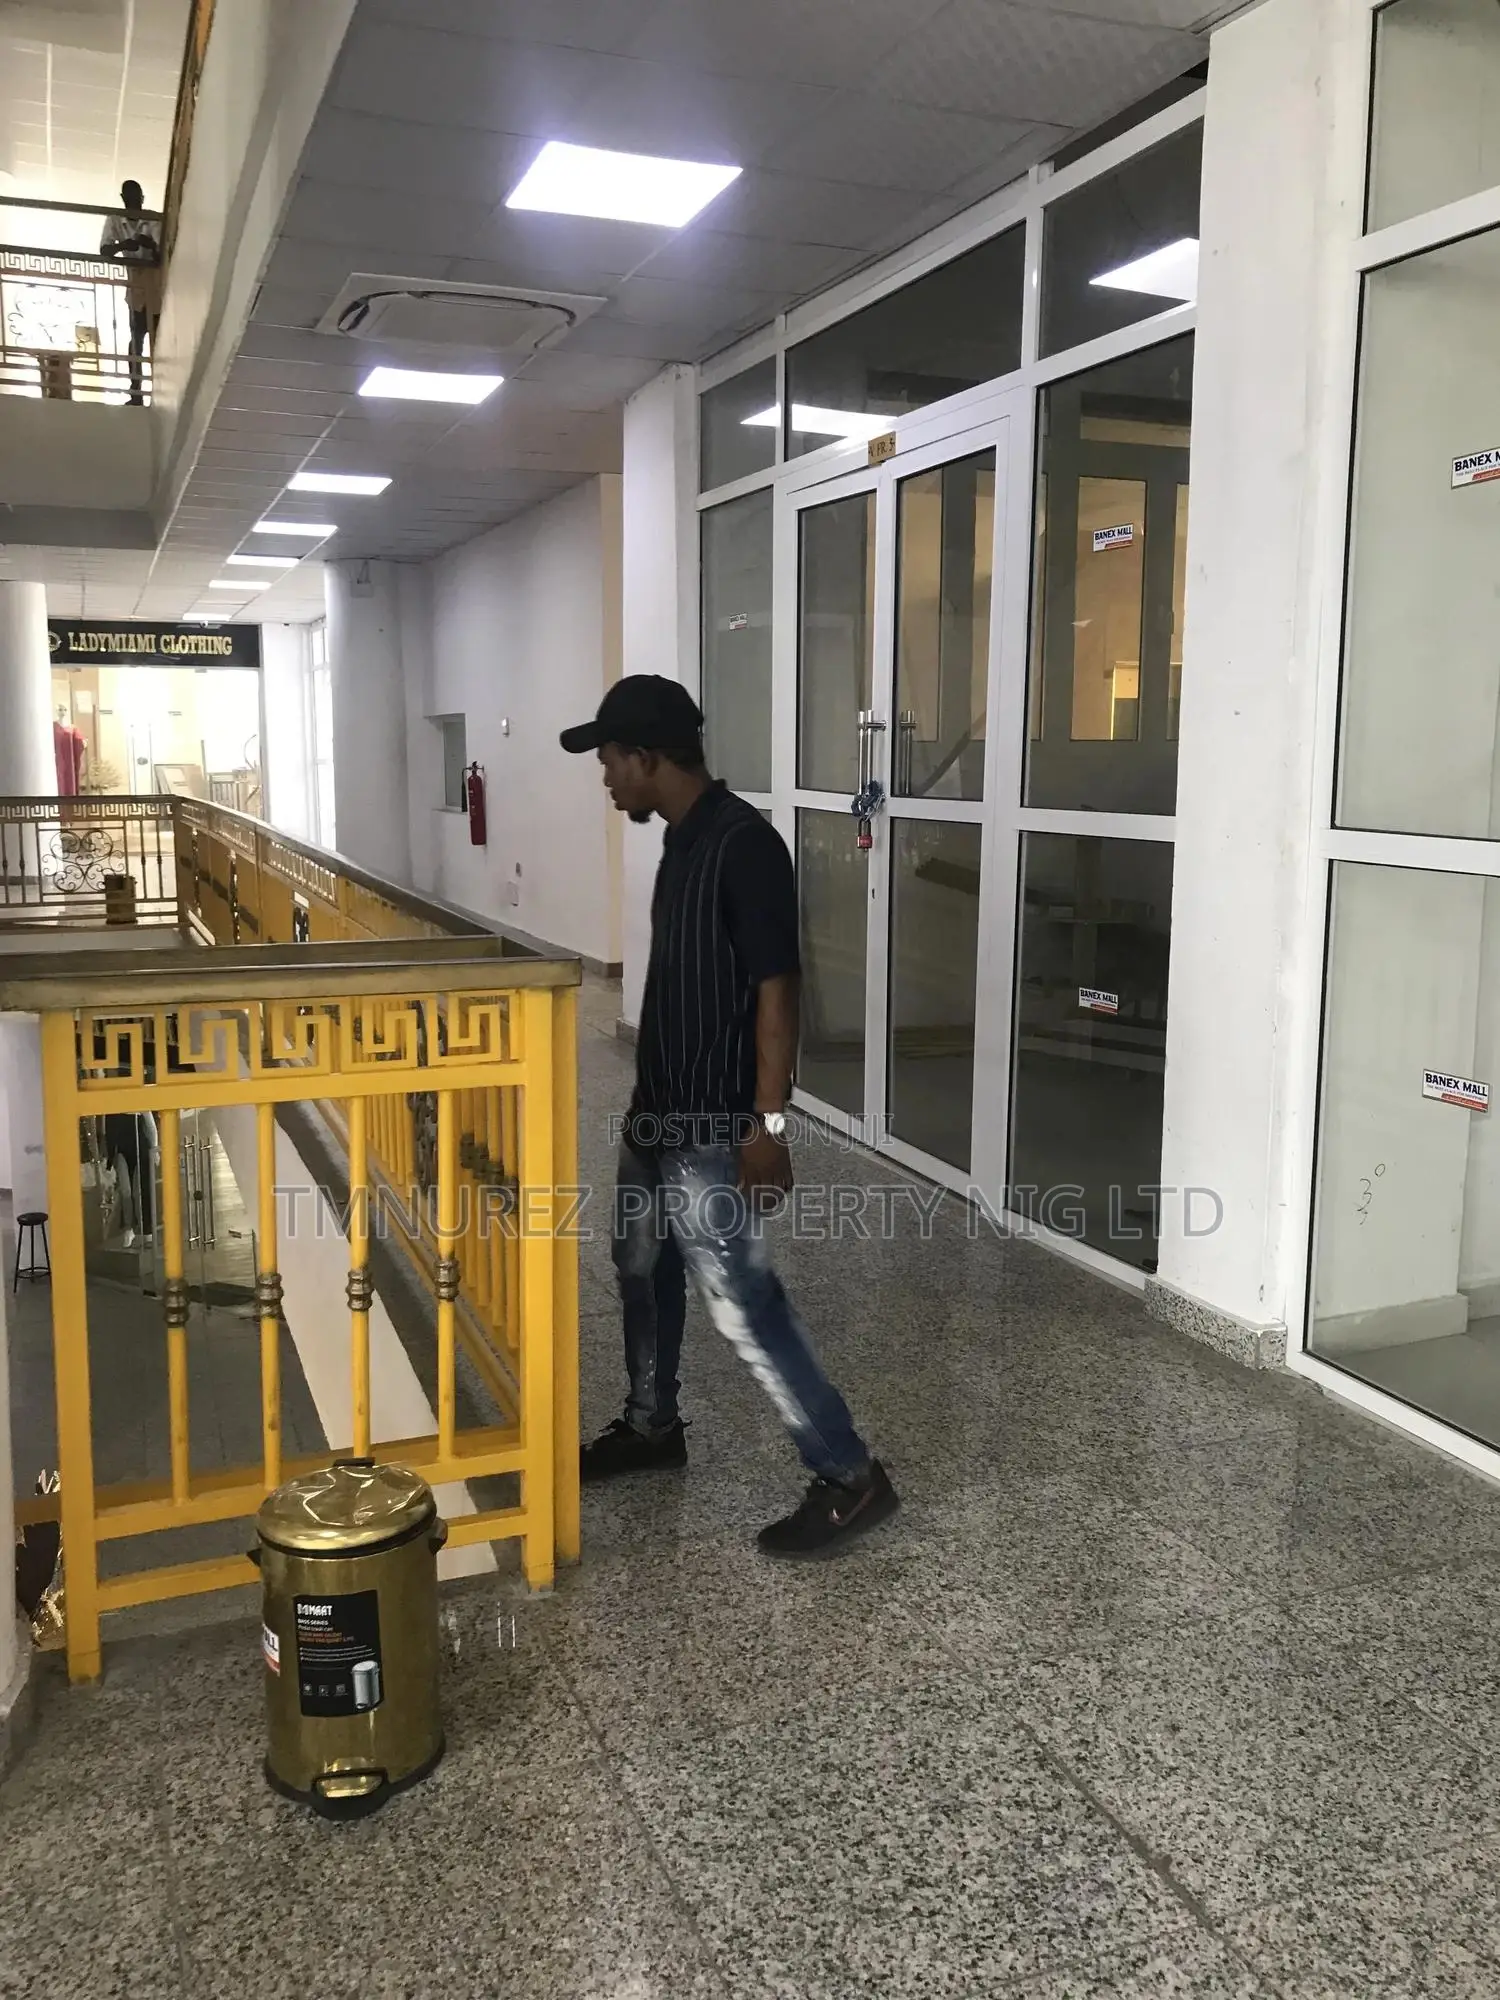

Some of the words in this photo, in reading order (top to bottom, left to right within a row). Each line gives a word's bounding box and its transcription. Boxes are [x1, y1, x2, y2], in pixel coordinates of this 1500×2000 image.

[1454, 453, 1492, 472] BANEX
[1094, 529, 1115, 541] BANEX
[1117, 526, 1133, 536] MALL
[67, 631, 156, 653] LADYMIAMI
[160, 634, 233, 655] CLOTHING
[1080, 989, 1101, 1001] BANEX
[1102, 994, 1118, 1004] MALL
[1425, 1072, 1460, 1090] BANEX
[1462, 1082, 1488, 1097] MALL
